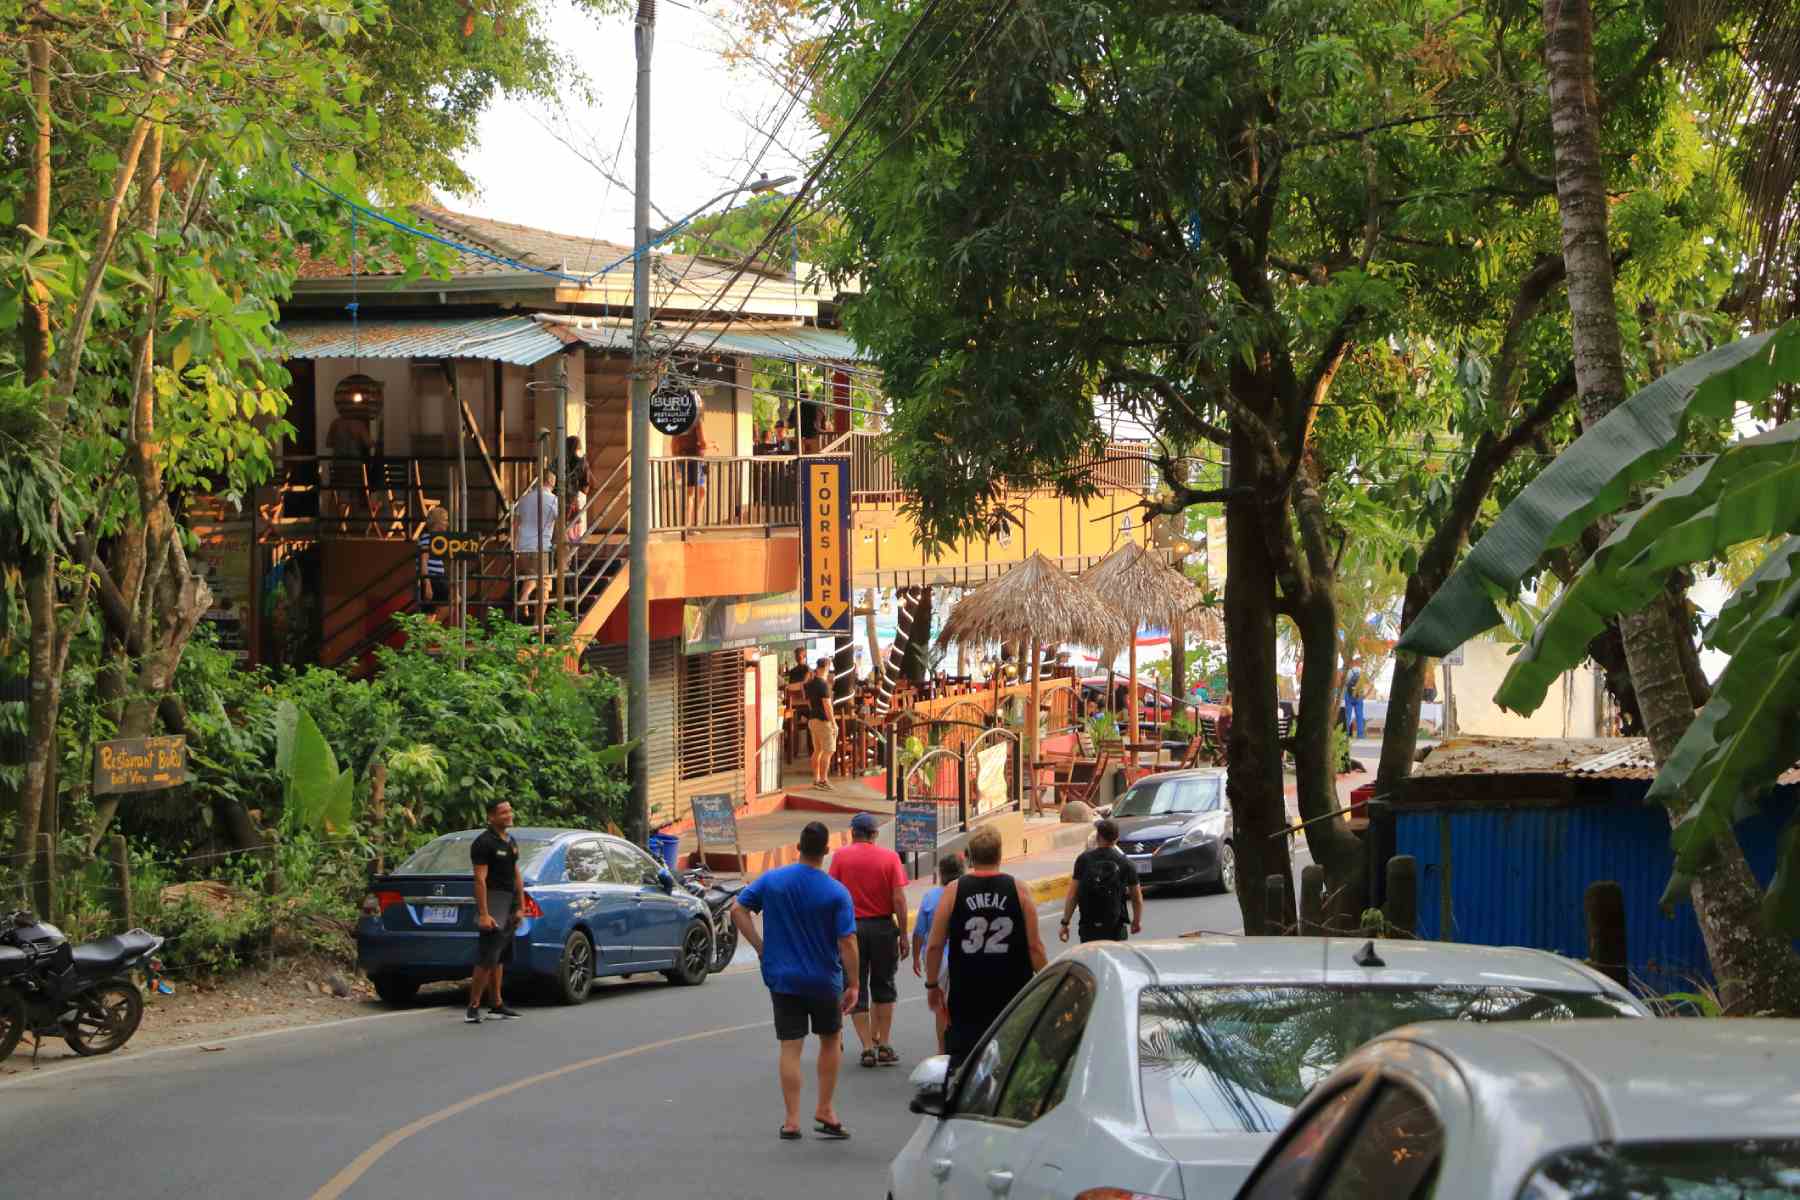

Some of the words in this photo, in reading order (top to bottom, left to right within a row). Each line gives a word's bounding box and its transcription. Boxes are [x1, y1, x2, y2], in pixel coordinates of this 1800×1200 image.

[818, 471, 831, 548] TOURS
[431, 535, 479, 559] Open
[820, 557, 832, 618] INFO
[966, 892, 1008, 911] O'NEAL
[961, 916, 1014, 954] 32
